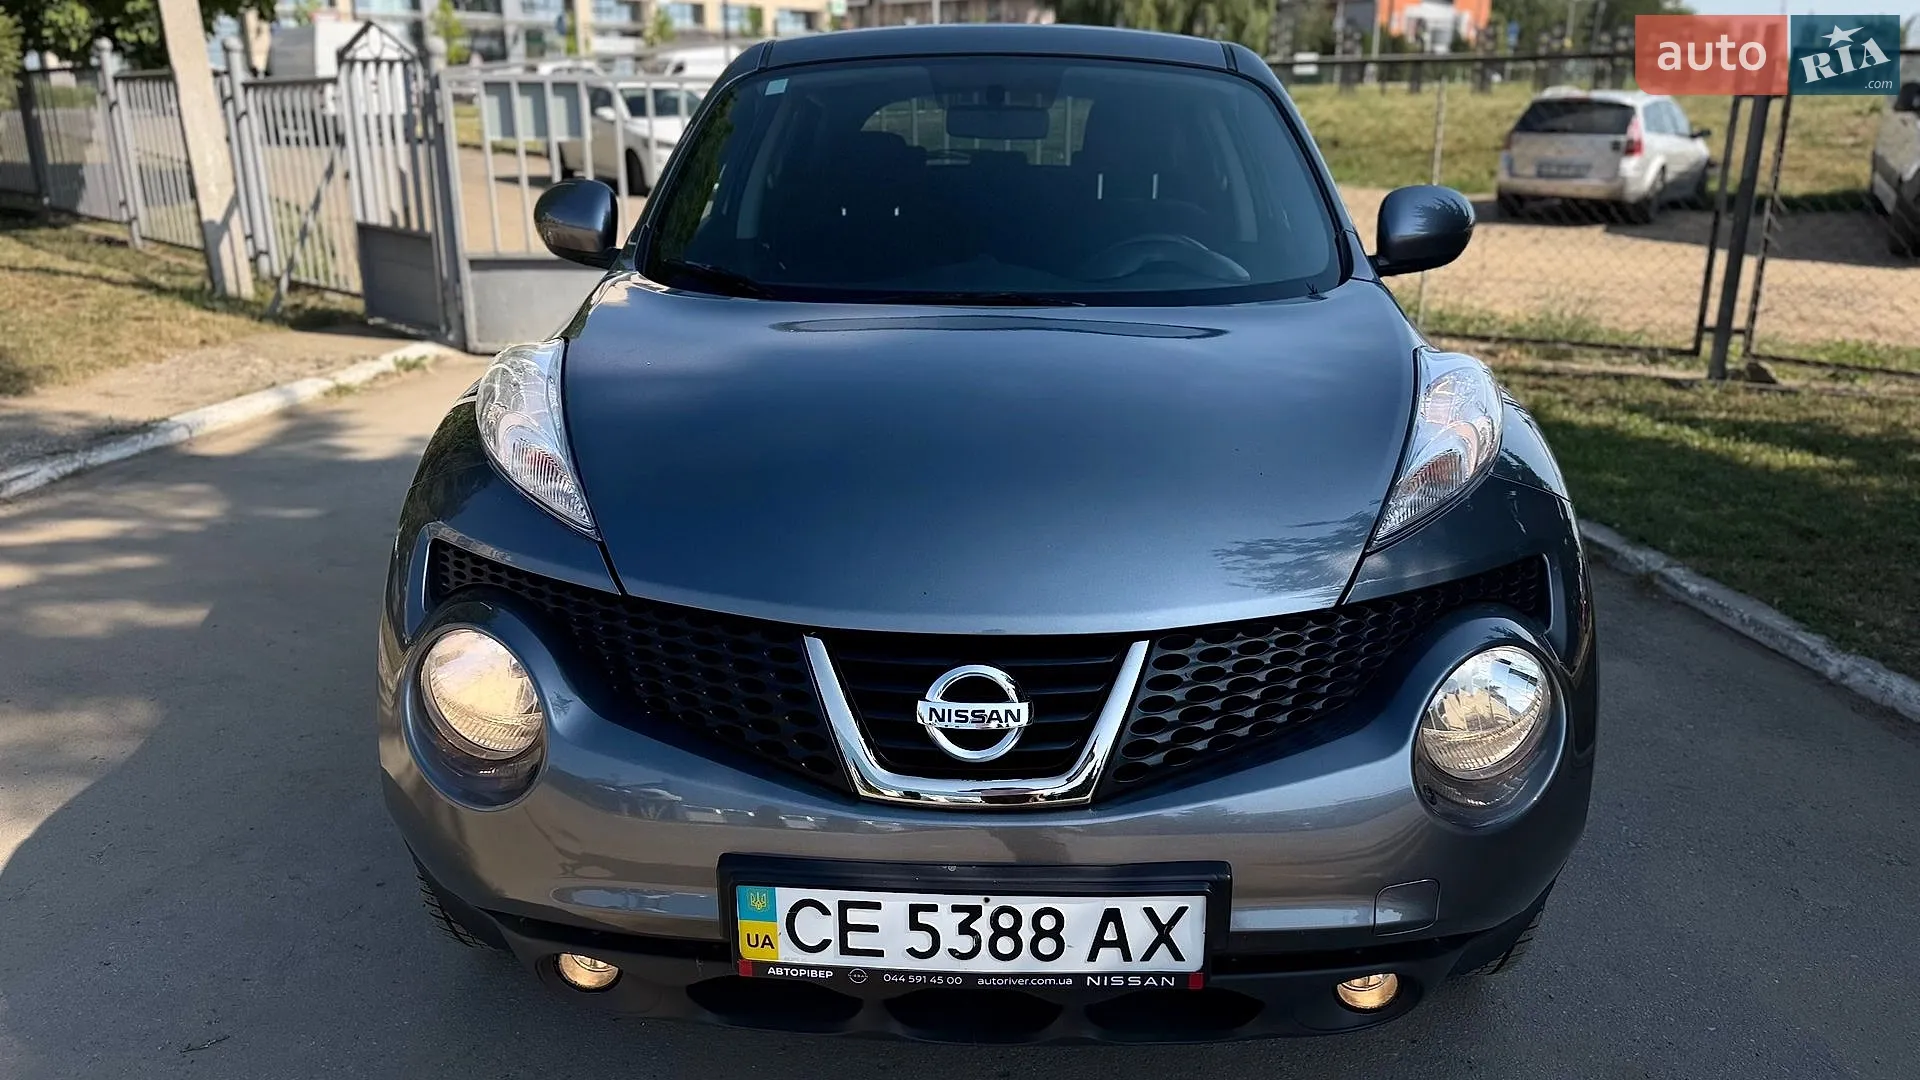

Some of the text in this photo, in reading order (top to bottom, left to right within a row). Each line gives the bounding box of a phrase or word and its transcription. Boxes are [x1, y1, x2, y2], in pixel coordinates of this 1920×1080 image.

[928, 707, 1021, 724] NISSAN
[785, 898, 1190, 963] CE 5388 AX
[746, 933, 775, 950] UA
[767, 966, 834, 979] АВТОРІВЕР
[883, 974, 963, 985] 044 591 45 00
[977, 976, 1073, 986] autoriver.com.ua
[1086, 976, 1175, 987] NISSAN
